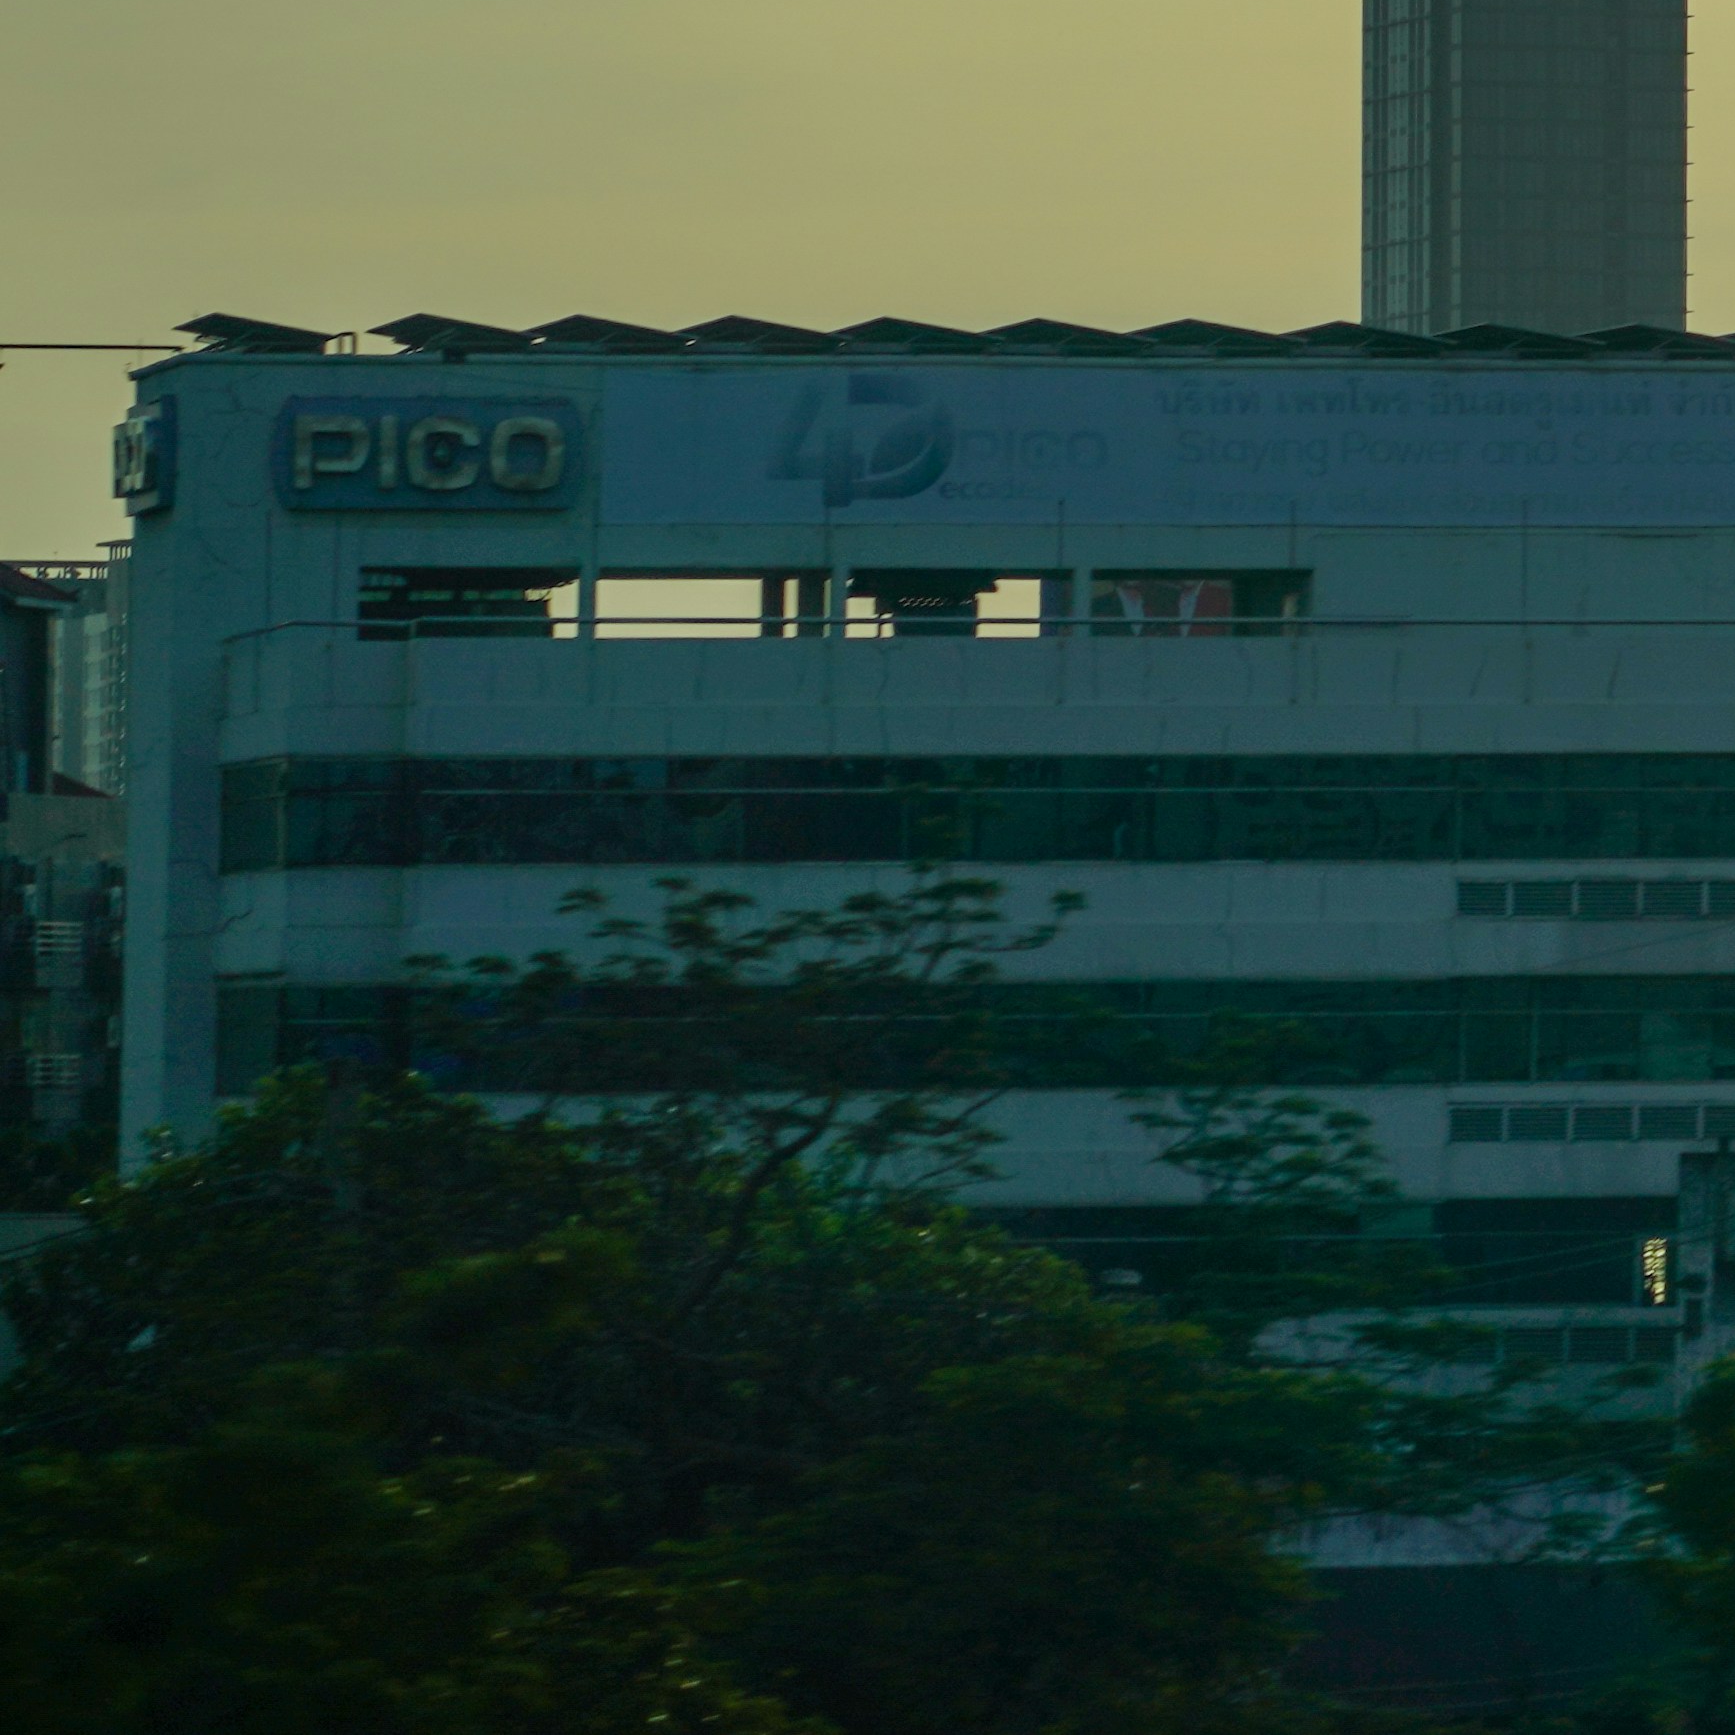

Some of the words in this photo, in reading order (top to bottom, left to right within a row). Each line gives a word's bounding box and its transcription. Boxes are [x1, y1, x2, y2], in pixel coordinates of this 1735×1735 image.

[292, 414, 565, 492] PICO
[1176, 429, 1331, 477] Staying
[1340, 430, 1468, 467] Power
[1480, 432, 1558, 467] and
